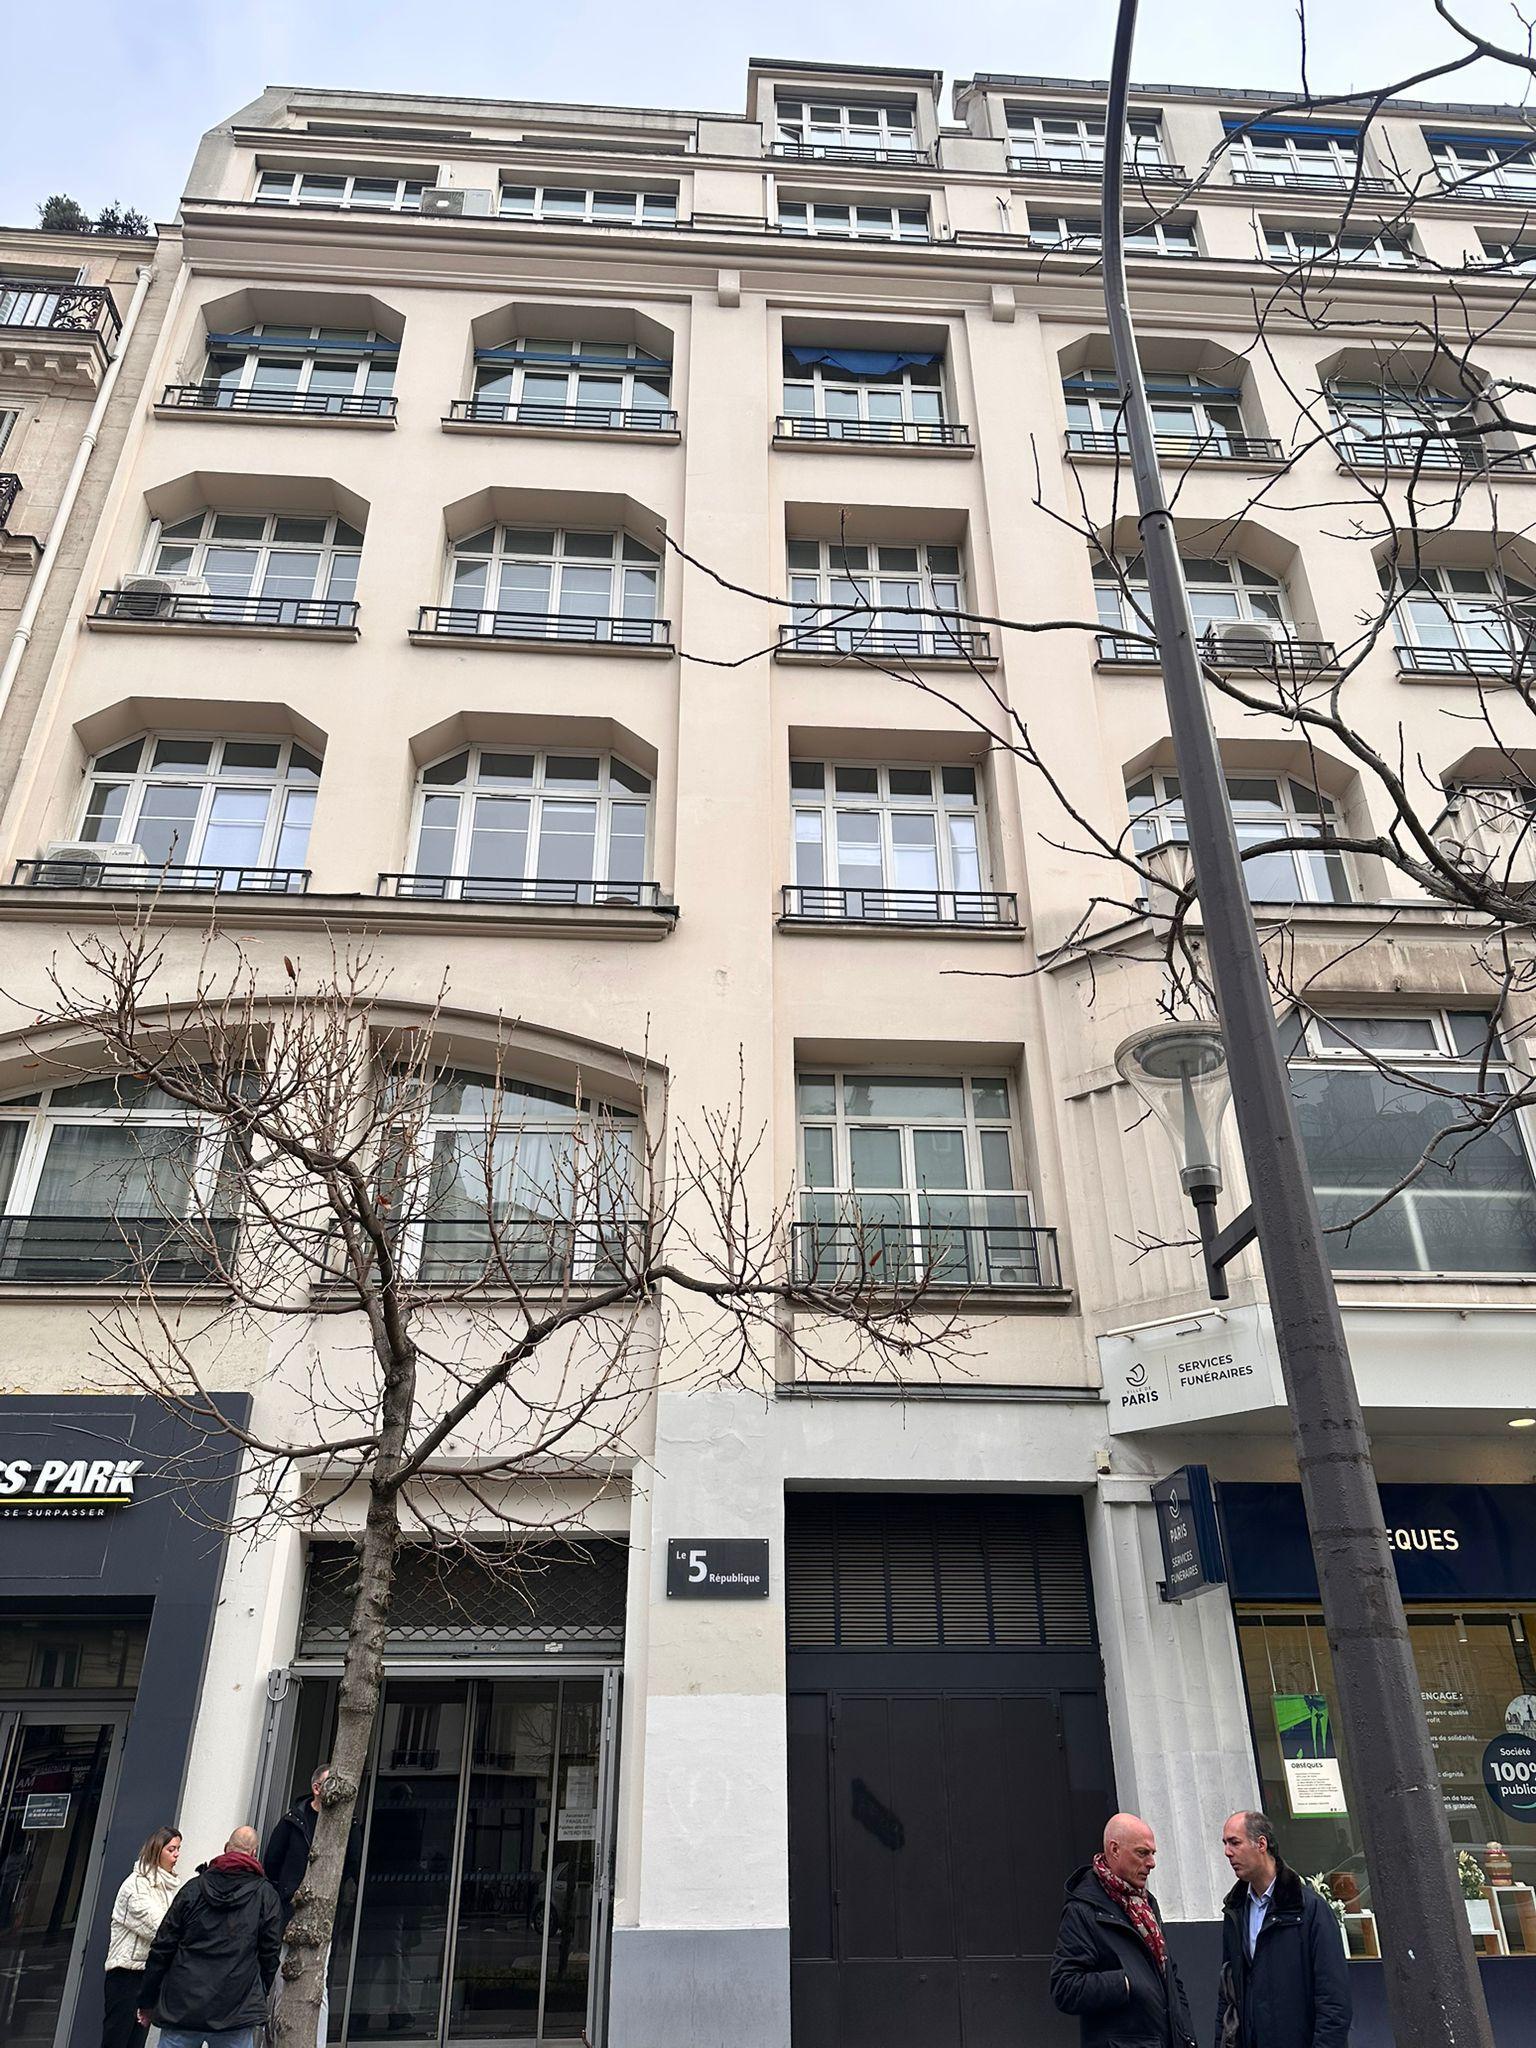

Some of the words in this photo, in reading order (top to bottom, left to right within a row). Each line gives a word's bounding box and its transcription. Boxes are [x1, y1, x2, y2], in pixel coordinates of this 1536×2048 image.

[1178, 1354, 1233, 1373] SERVICES
[1180, 1365, 1253, 1387] FUNÉRAIRES
[1121, 1390, 1158, 1407] PARIS
[0, 1460, 32, 1495] S
[32, 1460, 144, 1495] PARK
[4, 1509, 19, 1517] SE
[27, 1508, 105, 1517] SURPASSER
[1169, 1523, 1187, 1543] PARIS
[676, 1551, 687, 1559] Le
[688, 1550, 708, 1583] 5
[709, 1572, 761, 1585] République
[1172, 1550, 1193, 1567] SERVICES
[1499, 1747, 1531, 1756] Société
